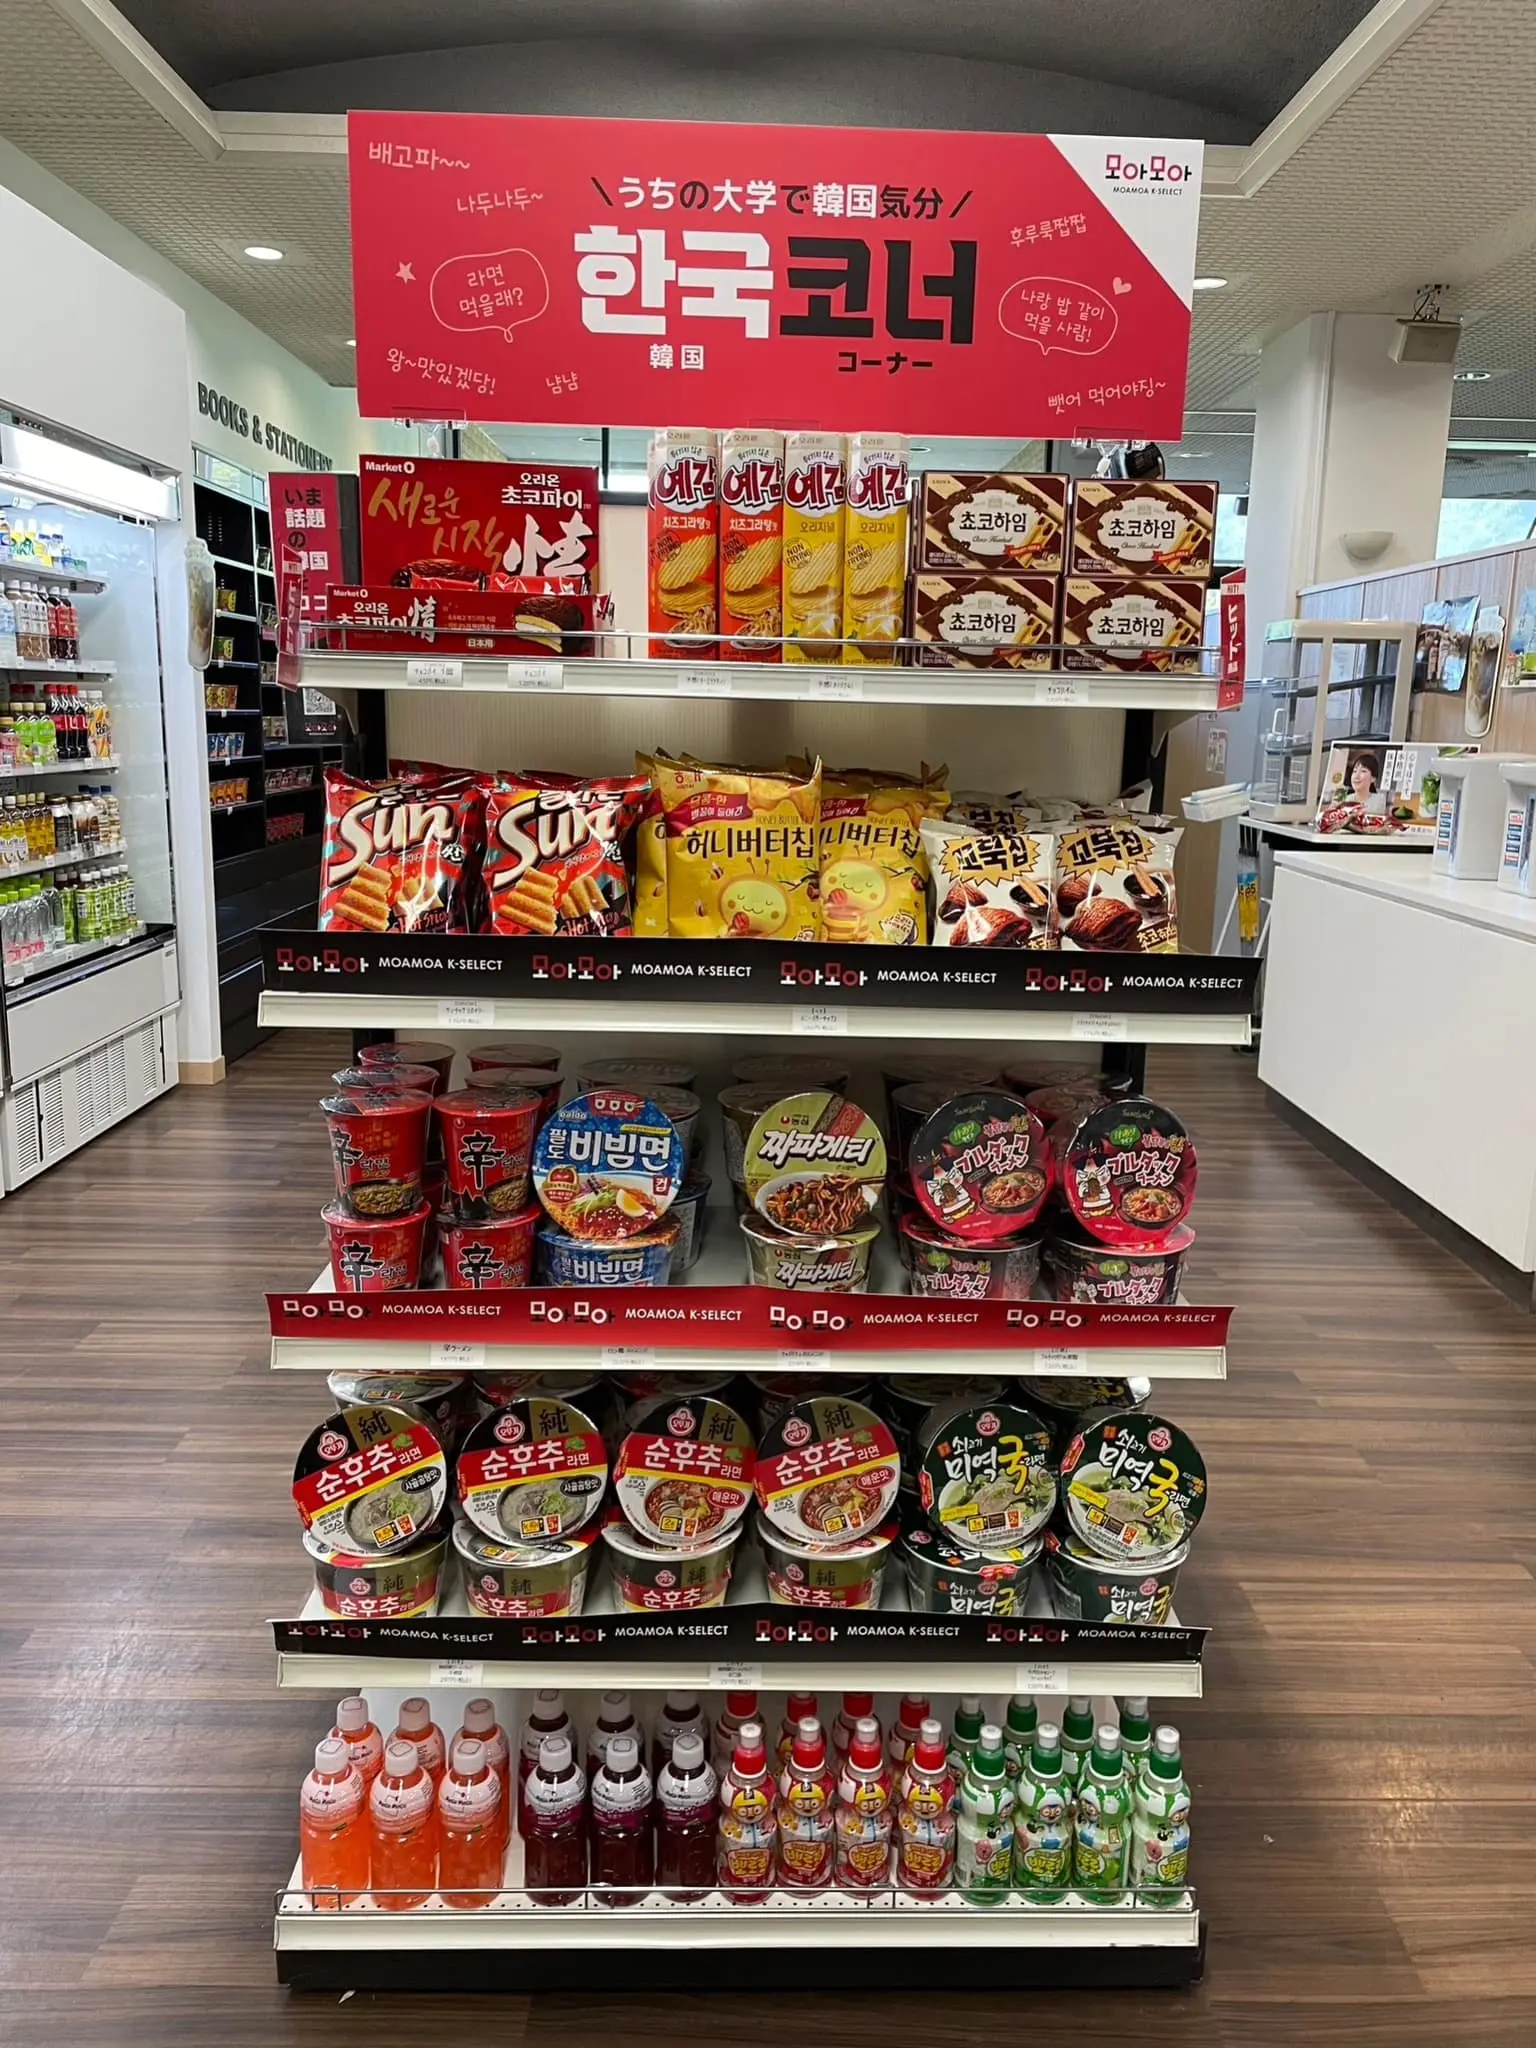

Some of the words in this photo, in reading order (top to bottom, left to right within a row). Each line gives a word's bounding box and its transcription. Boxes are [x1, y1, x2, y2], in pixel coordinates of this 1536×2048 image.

[1105, 154, 1192, 182] 모아모아
[1112, 185, 1148, 195] MOAMOA
[1151, 187, 1183, 196] K-SELECT
[466, 263, 505, 288] 라면
[573, 225, 978, 345] 한국코너
[459, 287, 524, 319] 먹을래?
[1020, 288, 1051, 312] 나랑
[1056, 296, 1072, 319] 밥
[1077, 298, 1105, 322] 같이
[1024, 311, 1052, 335] 먹을
[1056, 318, 1092, 344] 사람!
[649, 344, 705, 372] 韓国
[838, 352, 933, 375] コーナー
[546, 372, 579, 395] 냠냠
[1048, 389, 1081, 415] 뺏어
[1087, 377, 1167, 407] 먹어야징~
[198, 381, 249, 438] BOOKS
[252, 414, 263, 446] &
[266, 421, 334, 472] STATIONERY
[365, 462, 403, 474] Market
[404, 462, 415, 474] O
[519, 473, 561, 488] 오리온
[285, 488, 322, 506] いま
[368, 477, 461, 528] 새로운
[501, 486, 584, 510] 초코파이
[285, 508, 327, 530] 話題
[958, 511, 1027, 534] 쵸코하임
[1108, 518, 1176, 540] 쵸코하임
[288, 532, 306, 549] の
[433, 516, 505, 577] 시작
[787, 543, 805, 556] NON
[848, 544, 865, 556] NON
[786, 551, 811, 565] FRYING
[333, 588, 359, 599] Market
[360, 588, 369, 599] O
[353, 601, 390, 616] 오리온
[949, 611, 1017, 635] 쵸코하임
[1098, 616, 1165, 639] 쵸코하임
[328, 798, 456, 888] Sun
[493, 802, 619, 888] Sun
[686, 828, 815, 860] 허니버터칩
[1067, 829, 1145, 867] 꼬북칩
[276, 947, 368, 973] 모아모아
[378, 957, 443, 970] MOAMOA
[447, 959, 502, 971] K-SELECT
[531, 955, 622, 980] 모아모아
[631, 964, 693, 976] MOAMOA
[697, 965, 752, 978] K-SELECT
[780, 962, 867, 986] 모아모아
[877, 970, 938, 982] MOAMOA
[943, 972, 997, 984] K-SELECT
[1025, 968, 1112, 992] 모아모아
[1122, 976, 1184, 988] MOAMOA
[1188, 977, 1243, 989] K-SELECT
[329, 1124, 364, 1187] 辛
[459, 1129, 506, 1190] 辛
[570, 1131, 672, 1175] 비빔면
[757, 1130, 874, 1169] 짜파게티
[952, 1134, 1030, 1174] ブルダック
[988, 1153, 1029, 1175] ラーメン
[1105, 1151, 1182, 1176] ブルダック
[1135, 1171, 1176, 1187] ラーメン
[339, 1240, 386, 1292] 辛
[457, 1241, 505, 1289] 辛
[574, 1257, 645, 1284] 비빔면
[775, 1260, 856, 1288] 짜파게티
[927, 1273, 990, 1291] ブルダック
[1097, 1277, 1165, 1298] ブルダック
[283, 1300, 371, 1321] 모아모아
[382, 1303, 444, 1316] MOAMOA
[448, 1305, 501, 1317] K-SELECT
[530, 1301, 614, 1325] 모아모아
[625, 1308, 686, 1320] MOAMOA
[690, 1309, 742, 1322] K-SELECT
[769, 1306, 853, 1331] 모아모아
[863, 1312, 923, 1325] MOAMOA
[927, 1313, 978, 1325] K-SELECT
[1006, 1308, 1089, 1329] 모아모아
[1099, 1312, 1160, 1323] MOAMOA
[1164, 1313, 1216, 1324] K-SELECT
[356, 1410, 394, 1443] 純
[538, 1407, 569, 1437] 純
[706, 1412, 736, 1442] 純
[822, 1404, 856, 1435] 純
[480, 1440, 565, 1481] 순후추
[567, 1453, 590, 1467] 라면
[644, 1438, 722, 1475] 순후추
[721, 1465, 743, 1480] 라면
[775, 1436, 855, 1486] 순후추
[857, 1446, 881, 1461] 라면
[943, 1435, 1031, 1494] 미역국
[315, 1443, 398, 1503] 순후추
[397, 1447, 423, 1465] 라면
[1099, 1441, 1180, 1518] 미역국
[473, 1594, 528, 1618] 순후추
[643, 1590, 701, 1612] 순후추
[777, 1580, 831, 1608] 순후추
[340, 1595, 400, 1619] 순후추
[288, 1622, 371, 1639] 모아모아
[380, 1627, 439, 1641] MOAMOA
[442, 1631, 493, 1643] K-SELECT
[522, 1624, 606, 1644] 모아모아
[615, 1626, 673, 1638] MOAMOA
[678, 1625, 729, 1637] K-SELECT
[755, 1619, 838, 1644] 모아모아
[847, 1625, 905, 1636] MOAMOA
[908, 1626, 960, 1637] K-SELECT
[986, 1623, 1069, 1643] 모아모아
[1077, 1629, 1136, 1639] MOAMOA
[1139, 1630, 1191, 1640] K-SELECT
